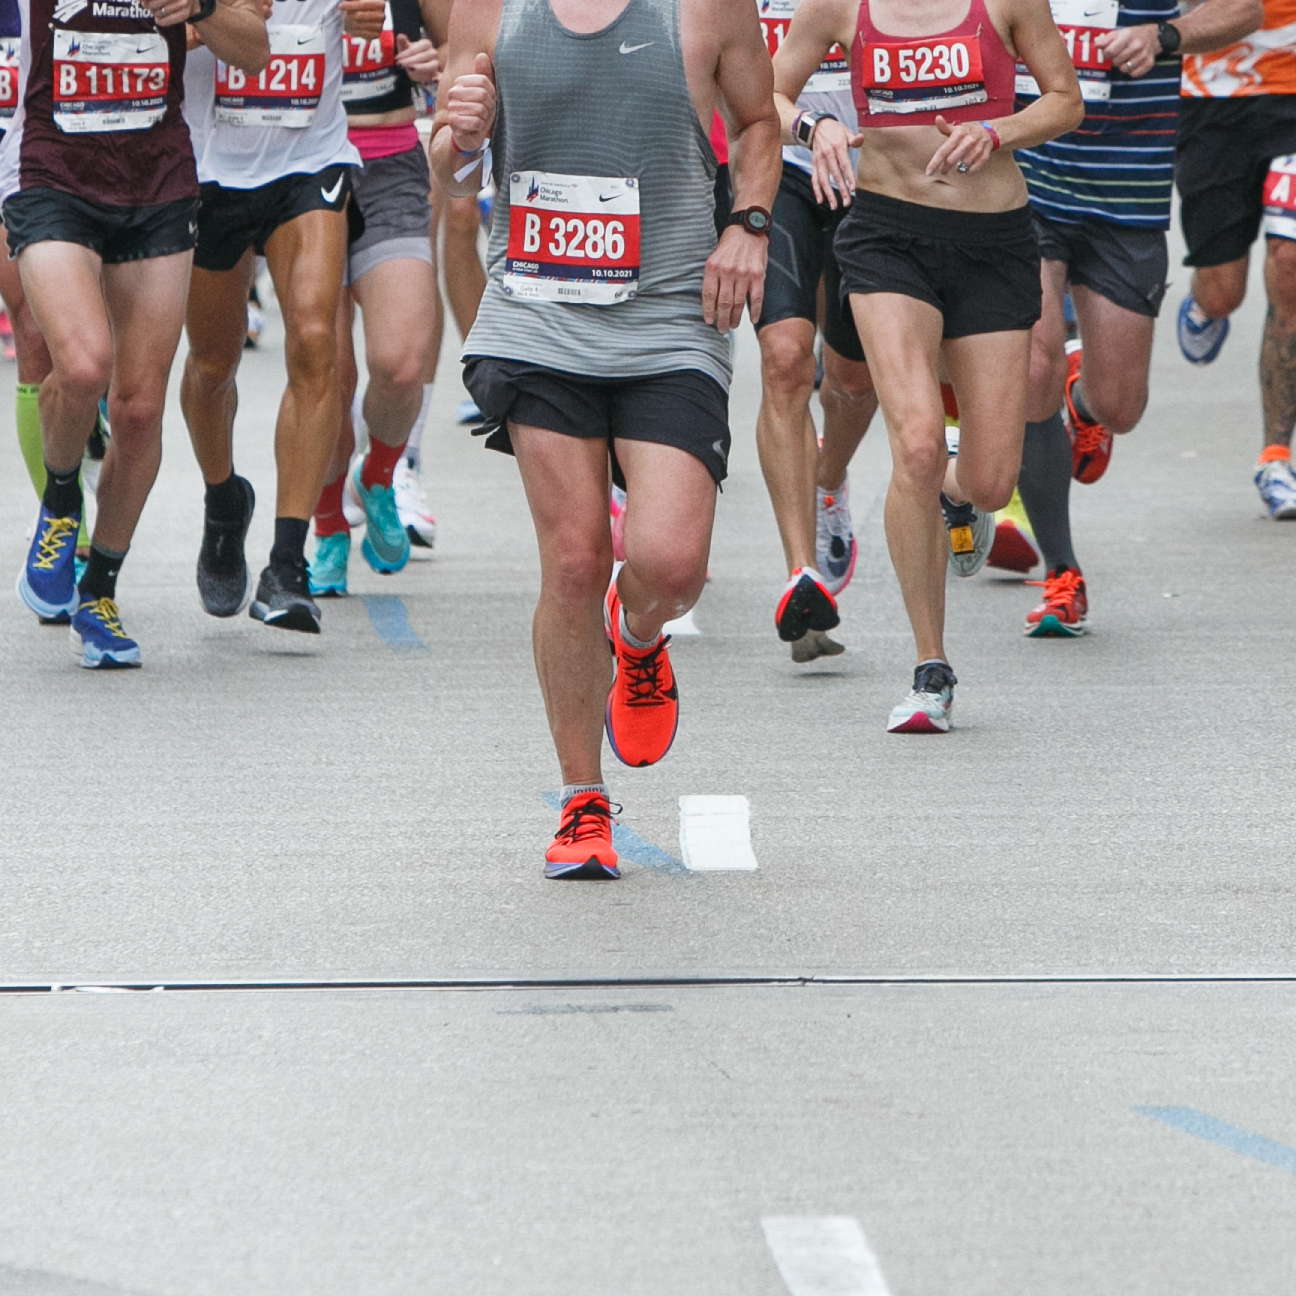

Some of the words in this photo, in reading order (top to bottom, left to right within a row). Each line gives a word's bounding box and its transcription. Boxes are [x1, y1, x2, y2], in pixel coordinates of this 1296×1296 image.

[92, 2, 154, 18] Maratho
[873, 47, 892, 83] B
[898, 42, 970, 83] 5230
[59, 64, 78, 96] B
[85, 65, 165, 95] 11173
[228, 65, 246, 90] B
[258, 58, 316, 91] 1214
[943, 83, 979, 94] 10.10.2021
[131, 98, 163, 107] 10.10.2021
[964, 97, 979, 106] 105
[540, 186, 563, 197] Chicago
[1269, 174, 1291, 203] A
[523, 212, 541, 253] B
[548, 216, 625, 260] 3286
[512, 260, 540, 270] CHICAGO
[591, 269, 633, 278] 10.10.2021
